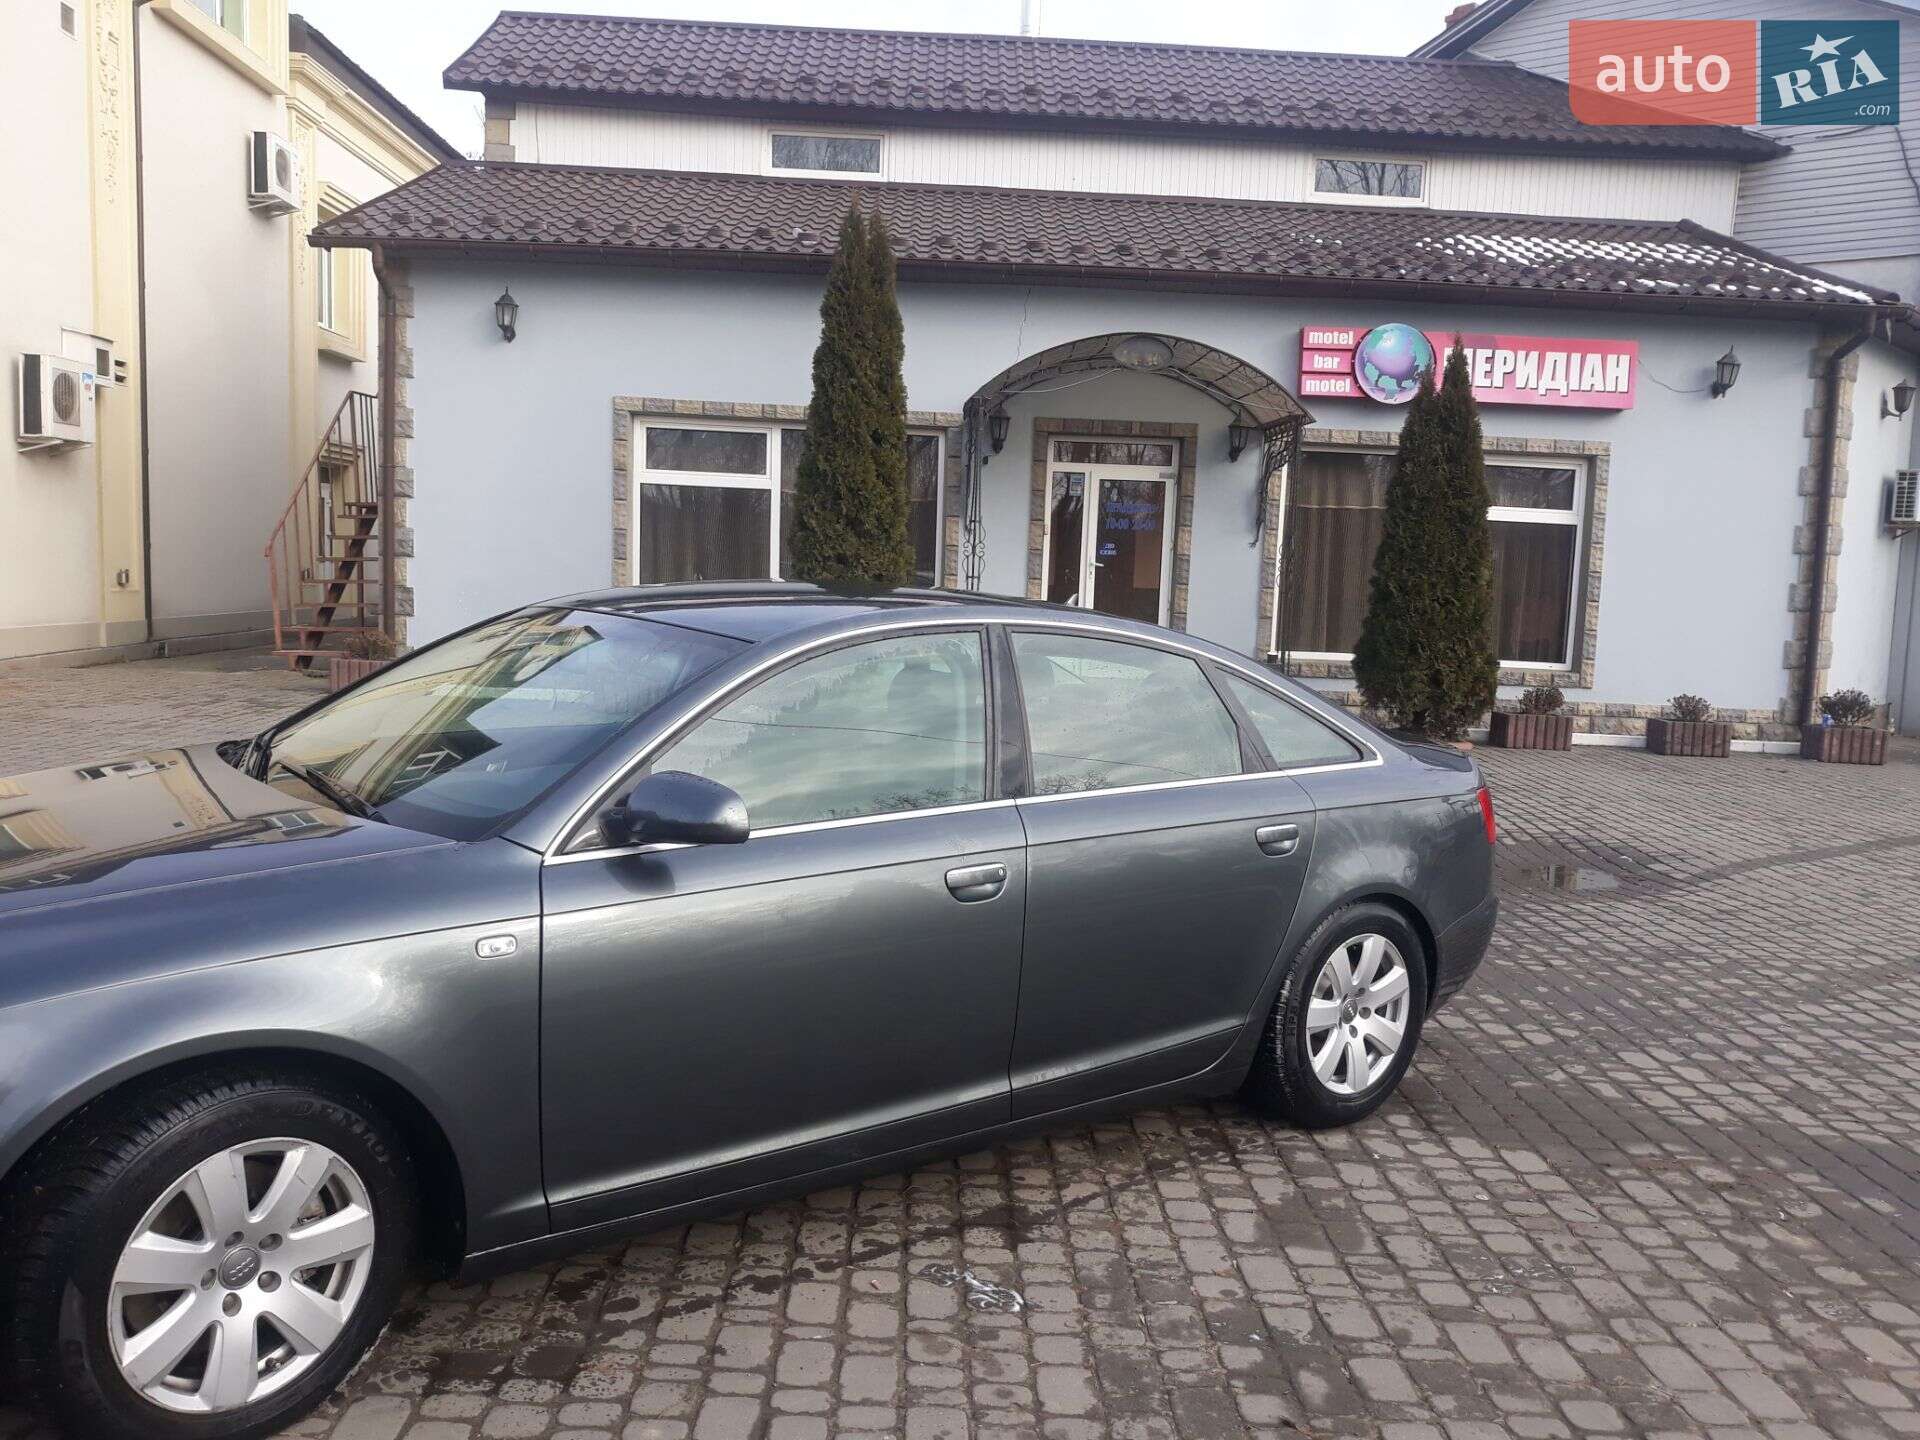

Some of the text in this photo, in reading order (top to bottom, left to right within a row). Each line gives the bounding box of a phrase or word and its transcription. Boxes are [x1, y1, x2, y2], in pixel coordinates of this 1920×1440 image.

[1308, 330, 1354, 345] motel
[1313, 353, 1340, 369] bar
[1304, 377, 1351, 393] motel
